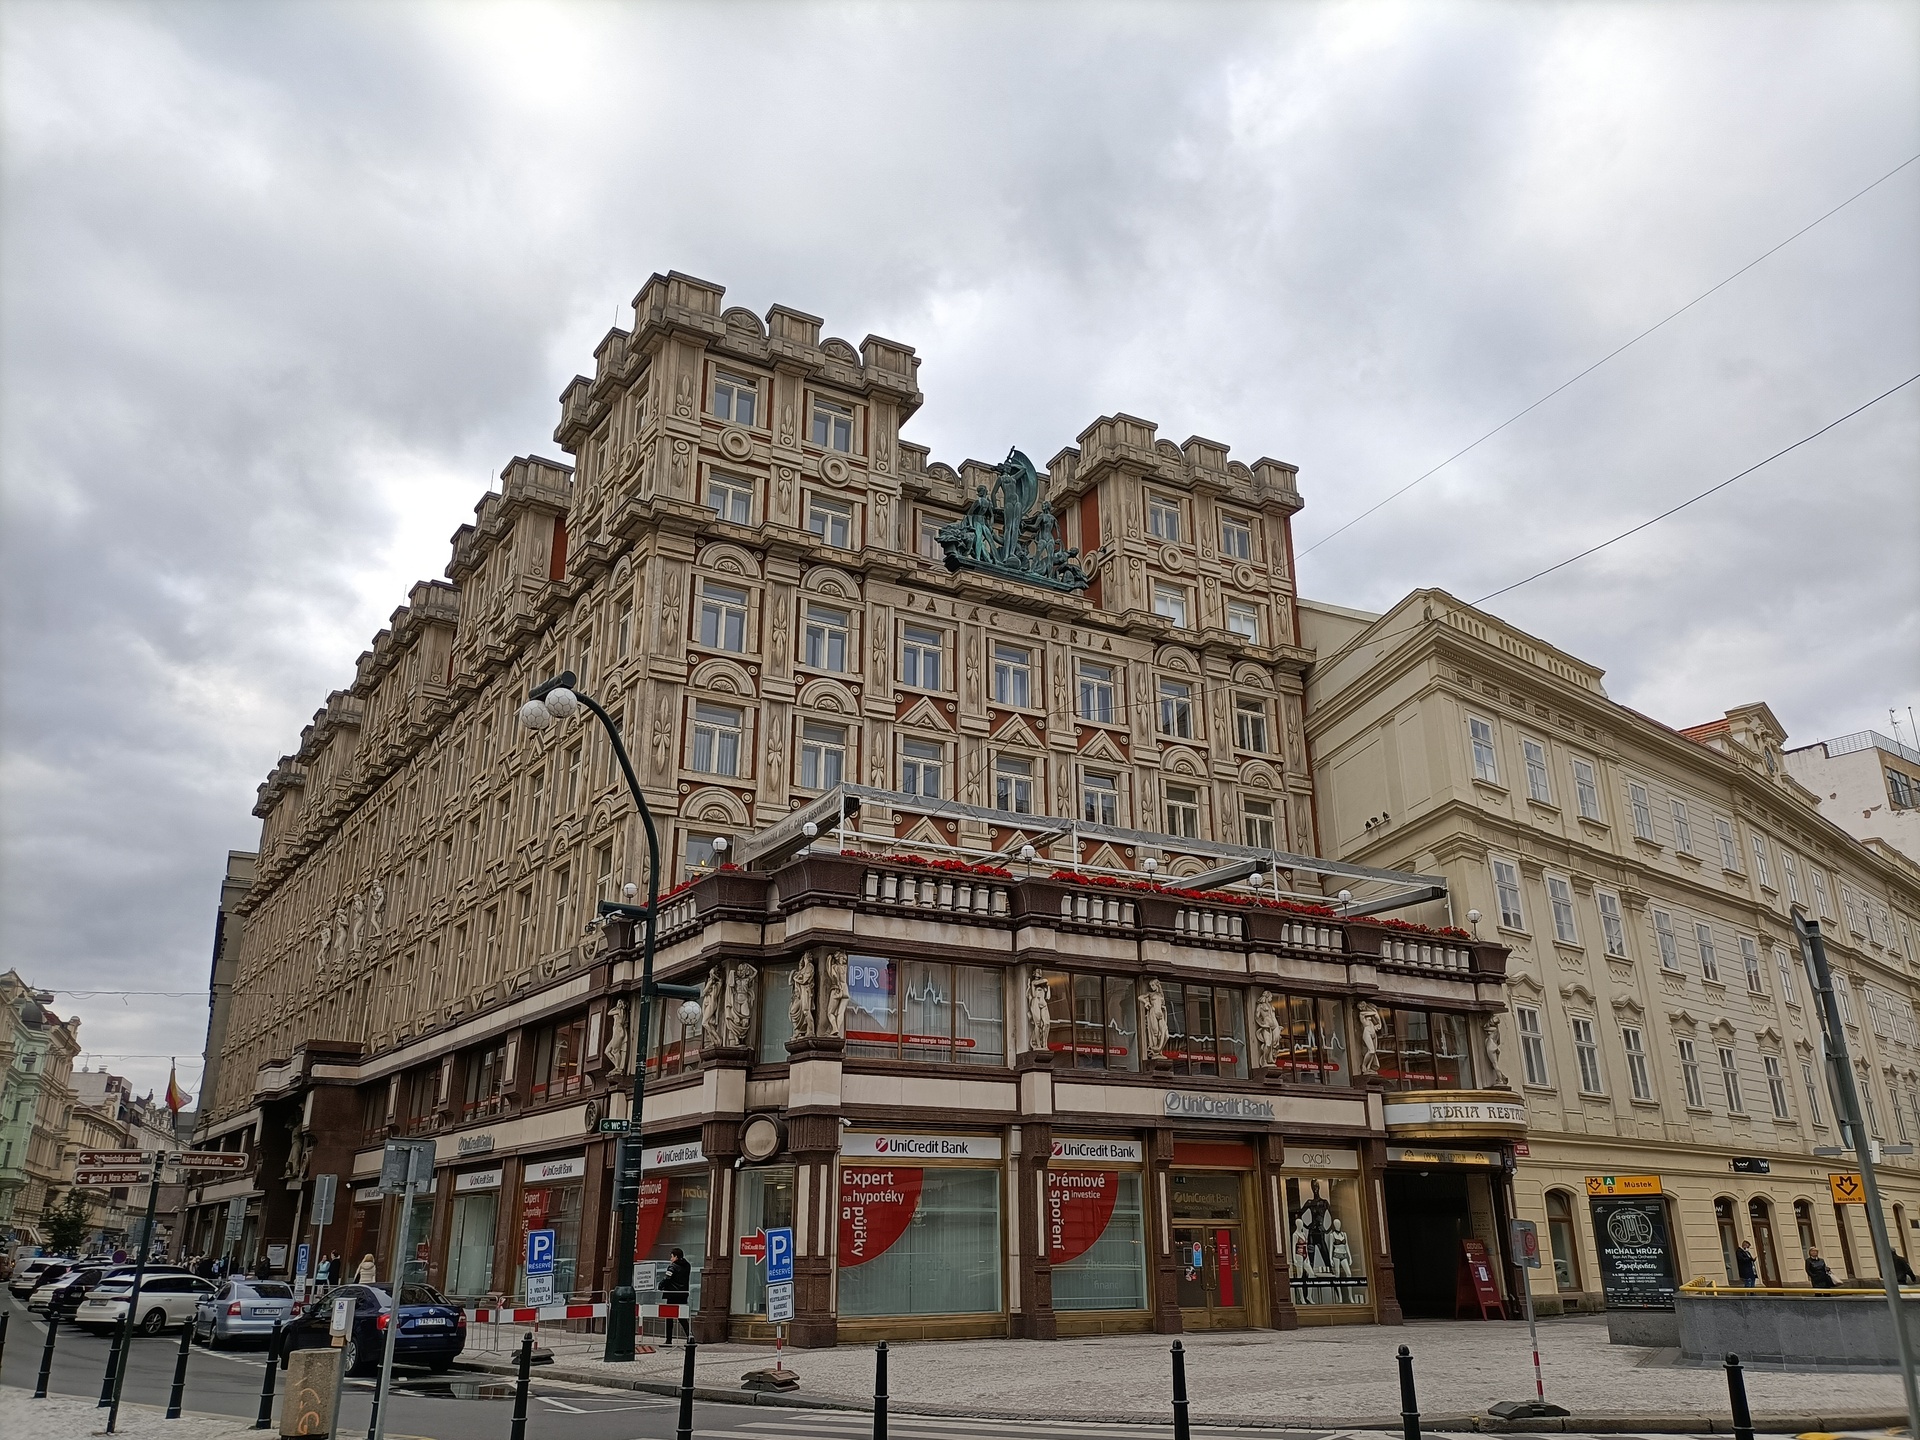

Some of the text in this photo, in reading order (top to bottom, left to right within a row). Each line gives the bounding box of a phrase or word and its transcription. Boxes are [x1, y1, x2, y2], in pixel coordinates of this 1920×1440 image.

[906, 593, 1112, 651] PALÁC ADRIA
[1182, 1095, 1275, 1116] UniCredit Bank
[1432, 1106, 1481, 1119] ADRIA
[611, 1121, 621, 1130] WC
[889, 1139, 969, 1154] UniCredit Bank
[1064, 1143, 1135, 1158] UniCredit Bank
[181, 1155, 223, 1166] Národní divadlo
[662, 1146, 698, 1163] UniCredit Bank
[1302, 1149, 1331, 1165] oxalis
[547, 1163, 573, 1177] UniCredit Bank
[842, 1170, 894, 1188] Expert
[1048, 1172, 1105, 1188] Prémiové
[1606, 1177, 1613, 1185] A
[639, 1179, 662, 1195] rémiové
[524, 1193, 540, 1206] Expert
[852, 1190, 904, 1205] hypotéky
[1062, 1190, 1101, 1201] a investice
[1183, 1192, 1215, 1203] UniCredit
[842, 1207, 851, 1219] a
[1049, 1190, 1065, 1250] spoření
[851, 1207, 868, 1257] půjčky
[534, 1236, 550, 1261] P
[771, 1236, 787, 1266] P
[1636, 1247, 1664, 1255] HRŮZA
[528, 1262, 551, 1270] RÉSERVÉ
[769, 1267, 791, 1277] RÉSERVÉ
[534, 1286, 551, 1295] VOZIDLA
[529, 1296, 544, 1304] POLICIE
